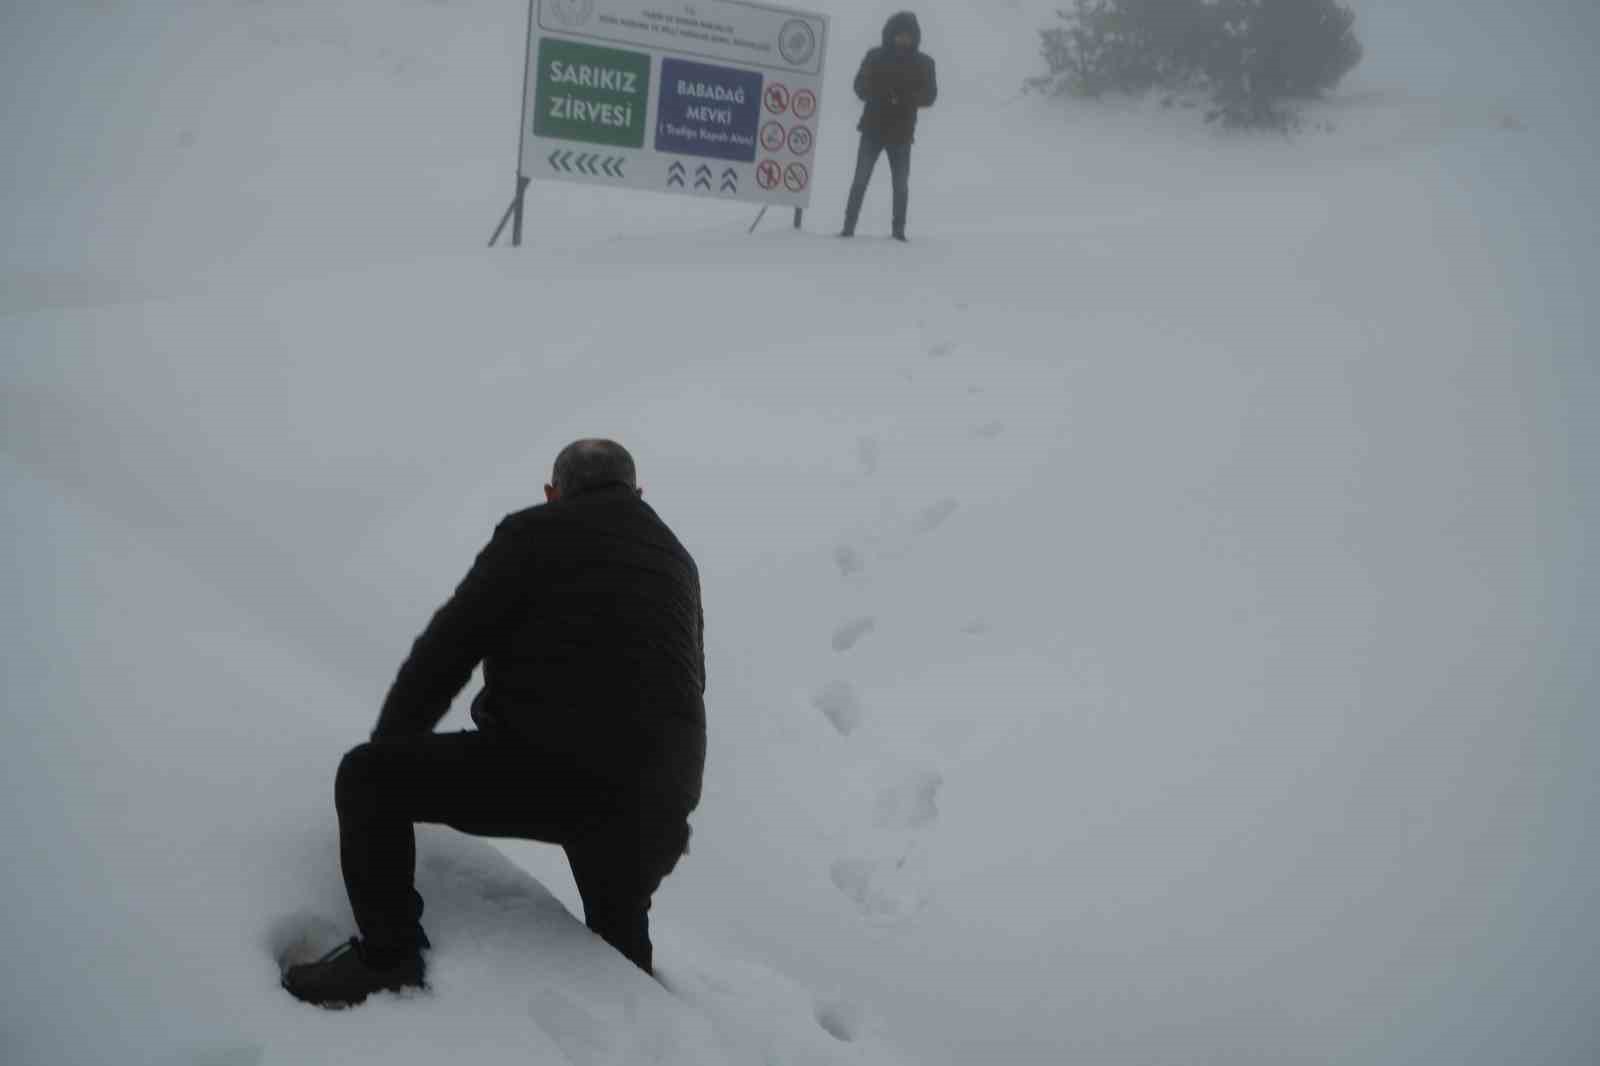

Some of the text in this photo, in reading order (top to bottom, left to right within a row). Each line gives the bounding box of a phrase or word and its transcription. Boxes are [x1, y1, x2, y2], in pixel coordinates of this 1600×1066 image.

[550, 60, 637, 93] SARIKIZ
[677, 79, 745, 105] BABADAĞ
[549, 93, 632, 128] ZİRVESİ
[685, 103, 732, 126] MEVKİ
